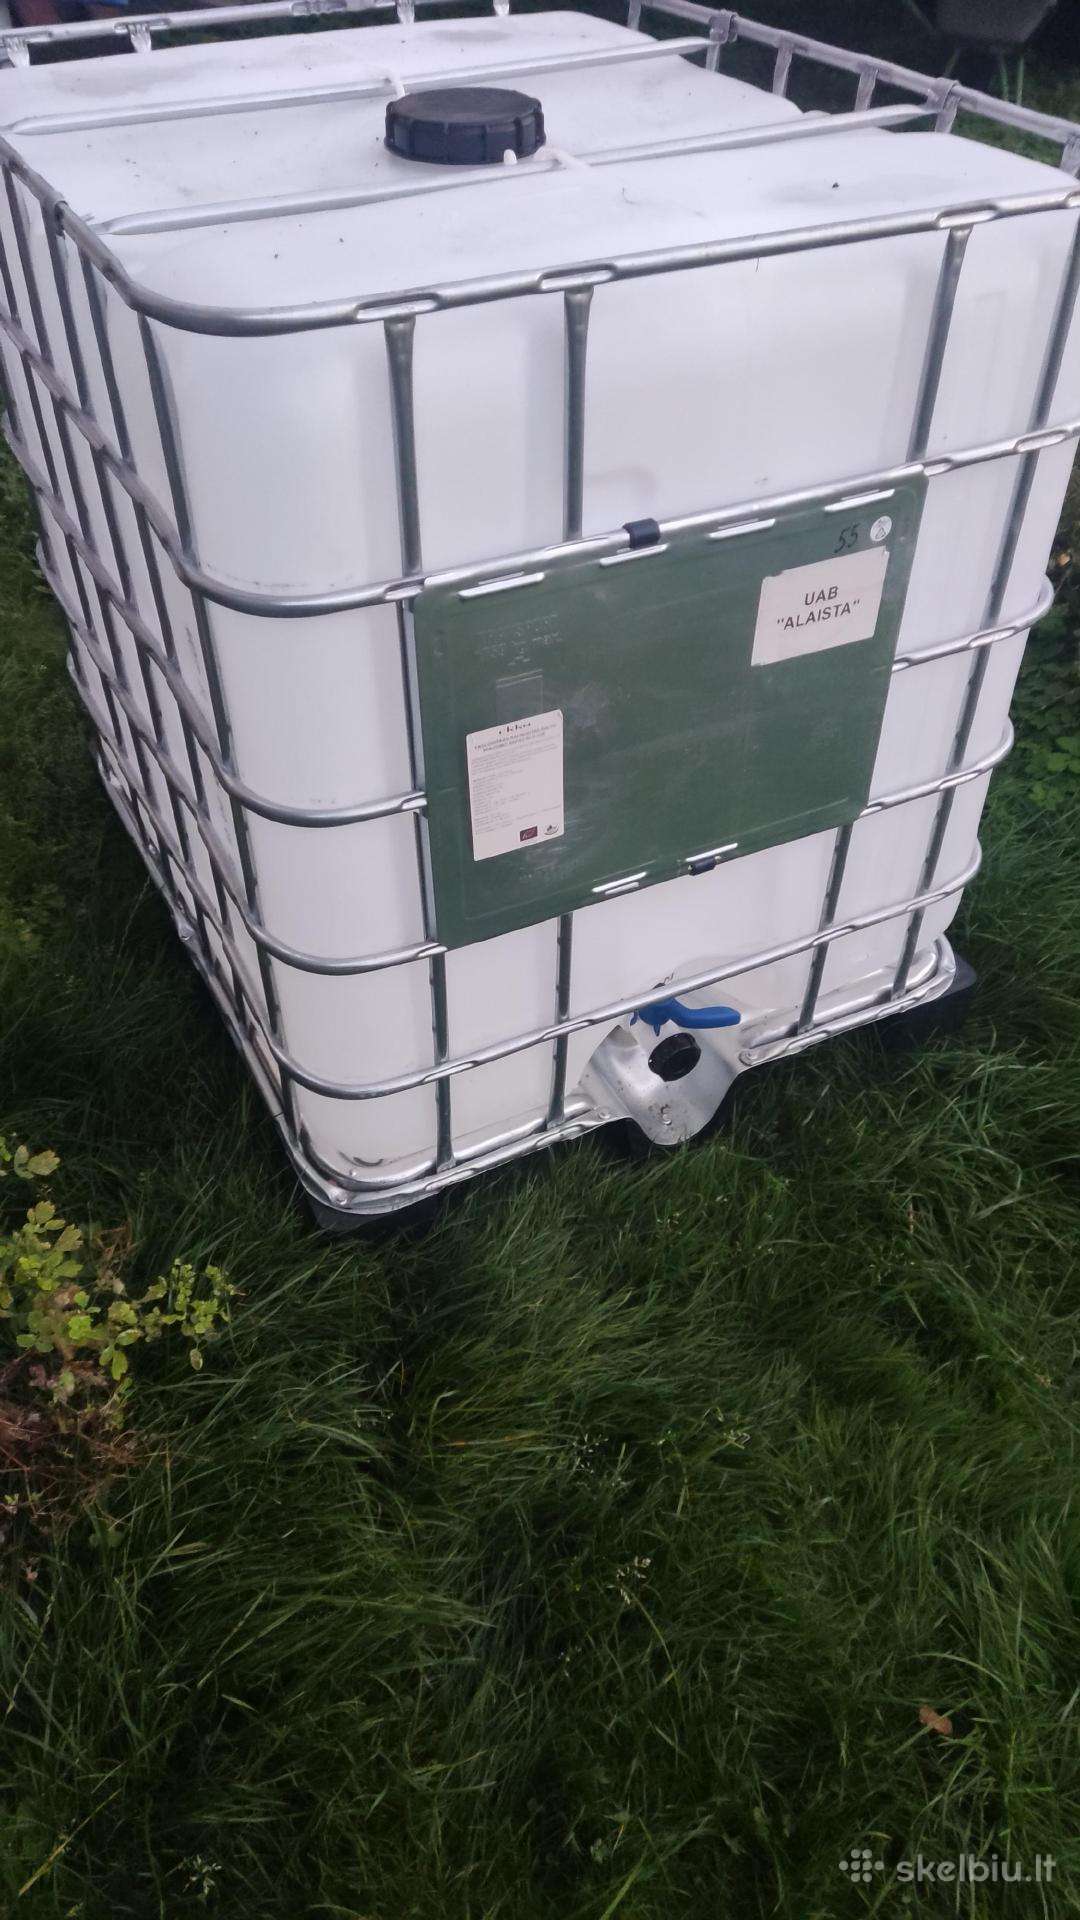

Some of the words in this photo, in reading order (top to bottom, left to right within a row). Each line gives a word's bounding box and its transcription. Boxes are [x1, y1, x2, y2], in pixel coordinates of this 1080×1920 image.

[833, 522, 861, 553] 55
[804, 586, 839, 606] UAB
[776, 599, 860, 631] "ALAISTA"
